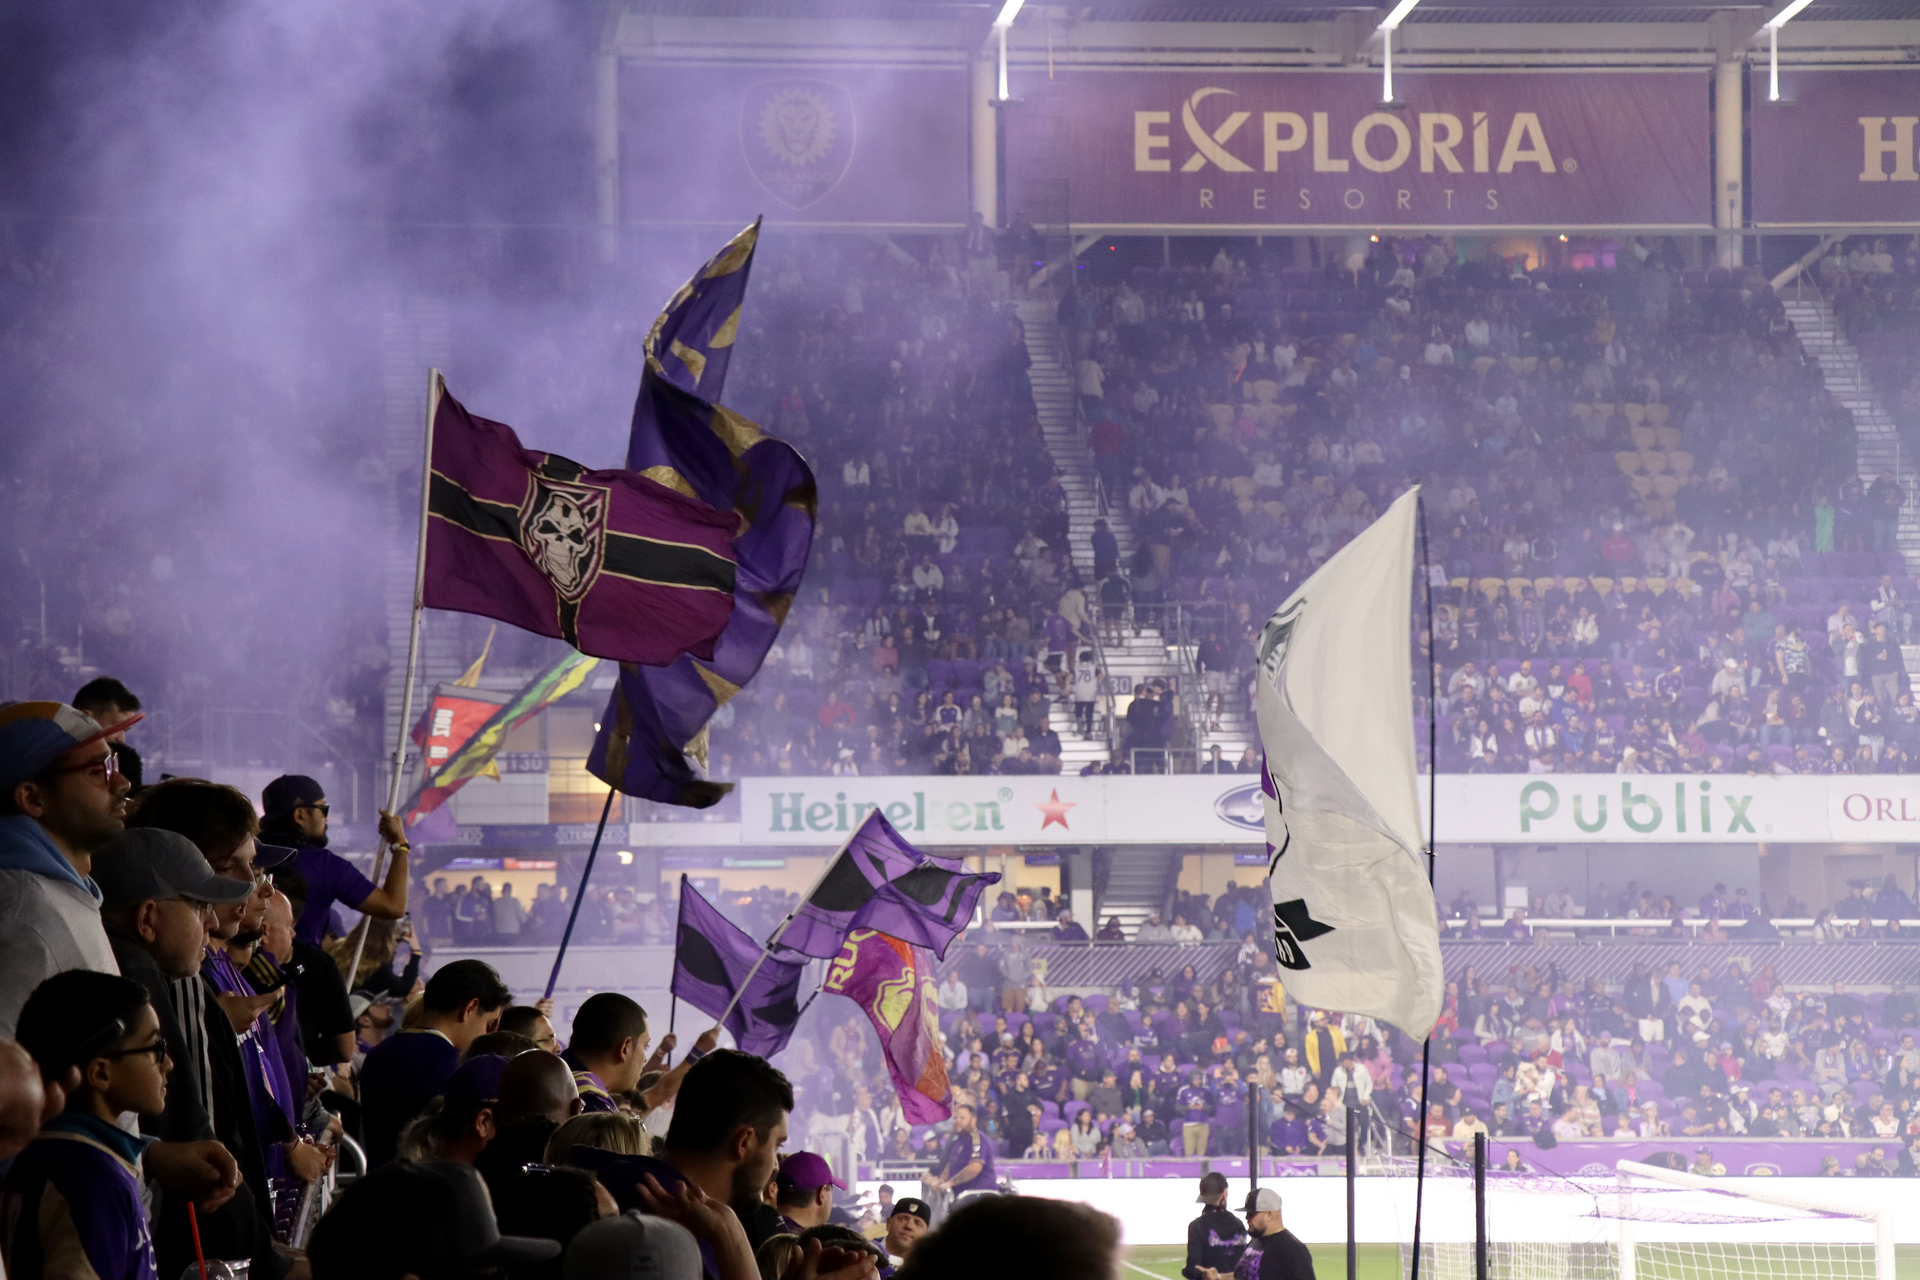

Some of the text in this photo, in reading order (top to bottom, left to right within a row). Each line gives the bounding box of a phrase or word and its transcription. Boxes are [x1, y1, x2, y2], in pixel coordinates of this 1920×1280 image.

[1135, 88, 1557, 172] EXPLORIA
[1859, 116, 1920, 181] H
[1200, 187, 1498, 210] RESORTS
[1078, 669, 1092, 683] 78
[1520, 780, 1756, 833] Publix
[1843, 793, 1920, 822] ORL
